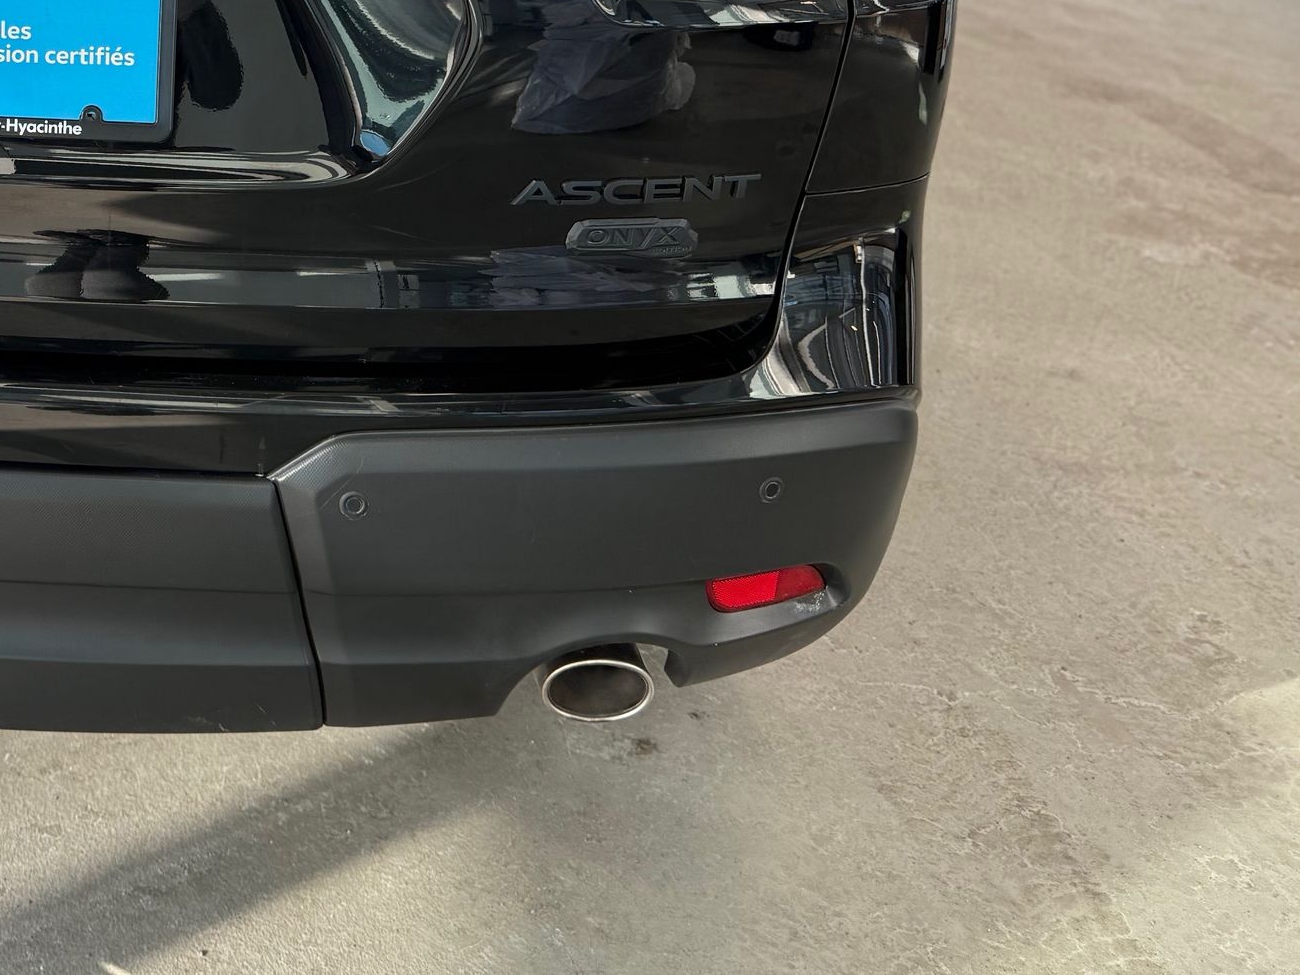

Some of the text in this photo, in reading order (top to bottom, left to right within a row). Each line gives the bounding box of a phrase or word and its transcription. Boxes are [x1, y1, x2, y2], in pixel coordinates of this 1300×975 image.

[44, 45, 135, 67] certifiés
[509, 173, 762, 206] ASCENT
[586, 226, 681, 249] ONYX
